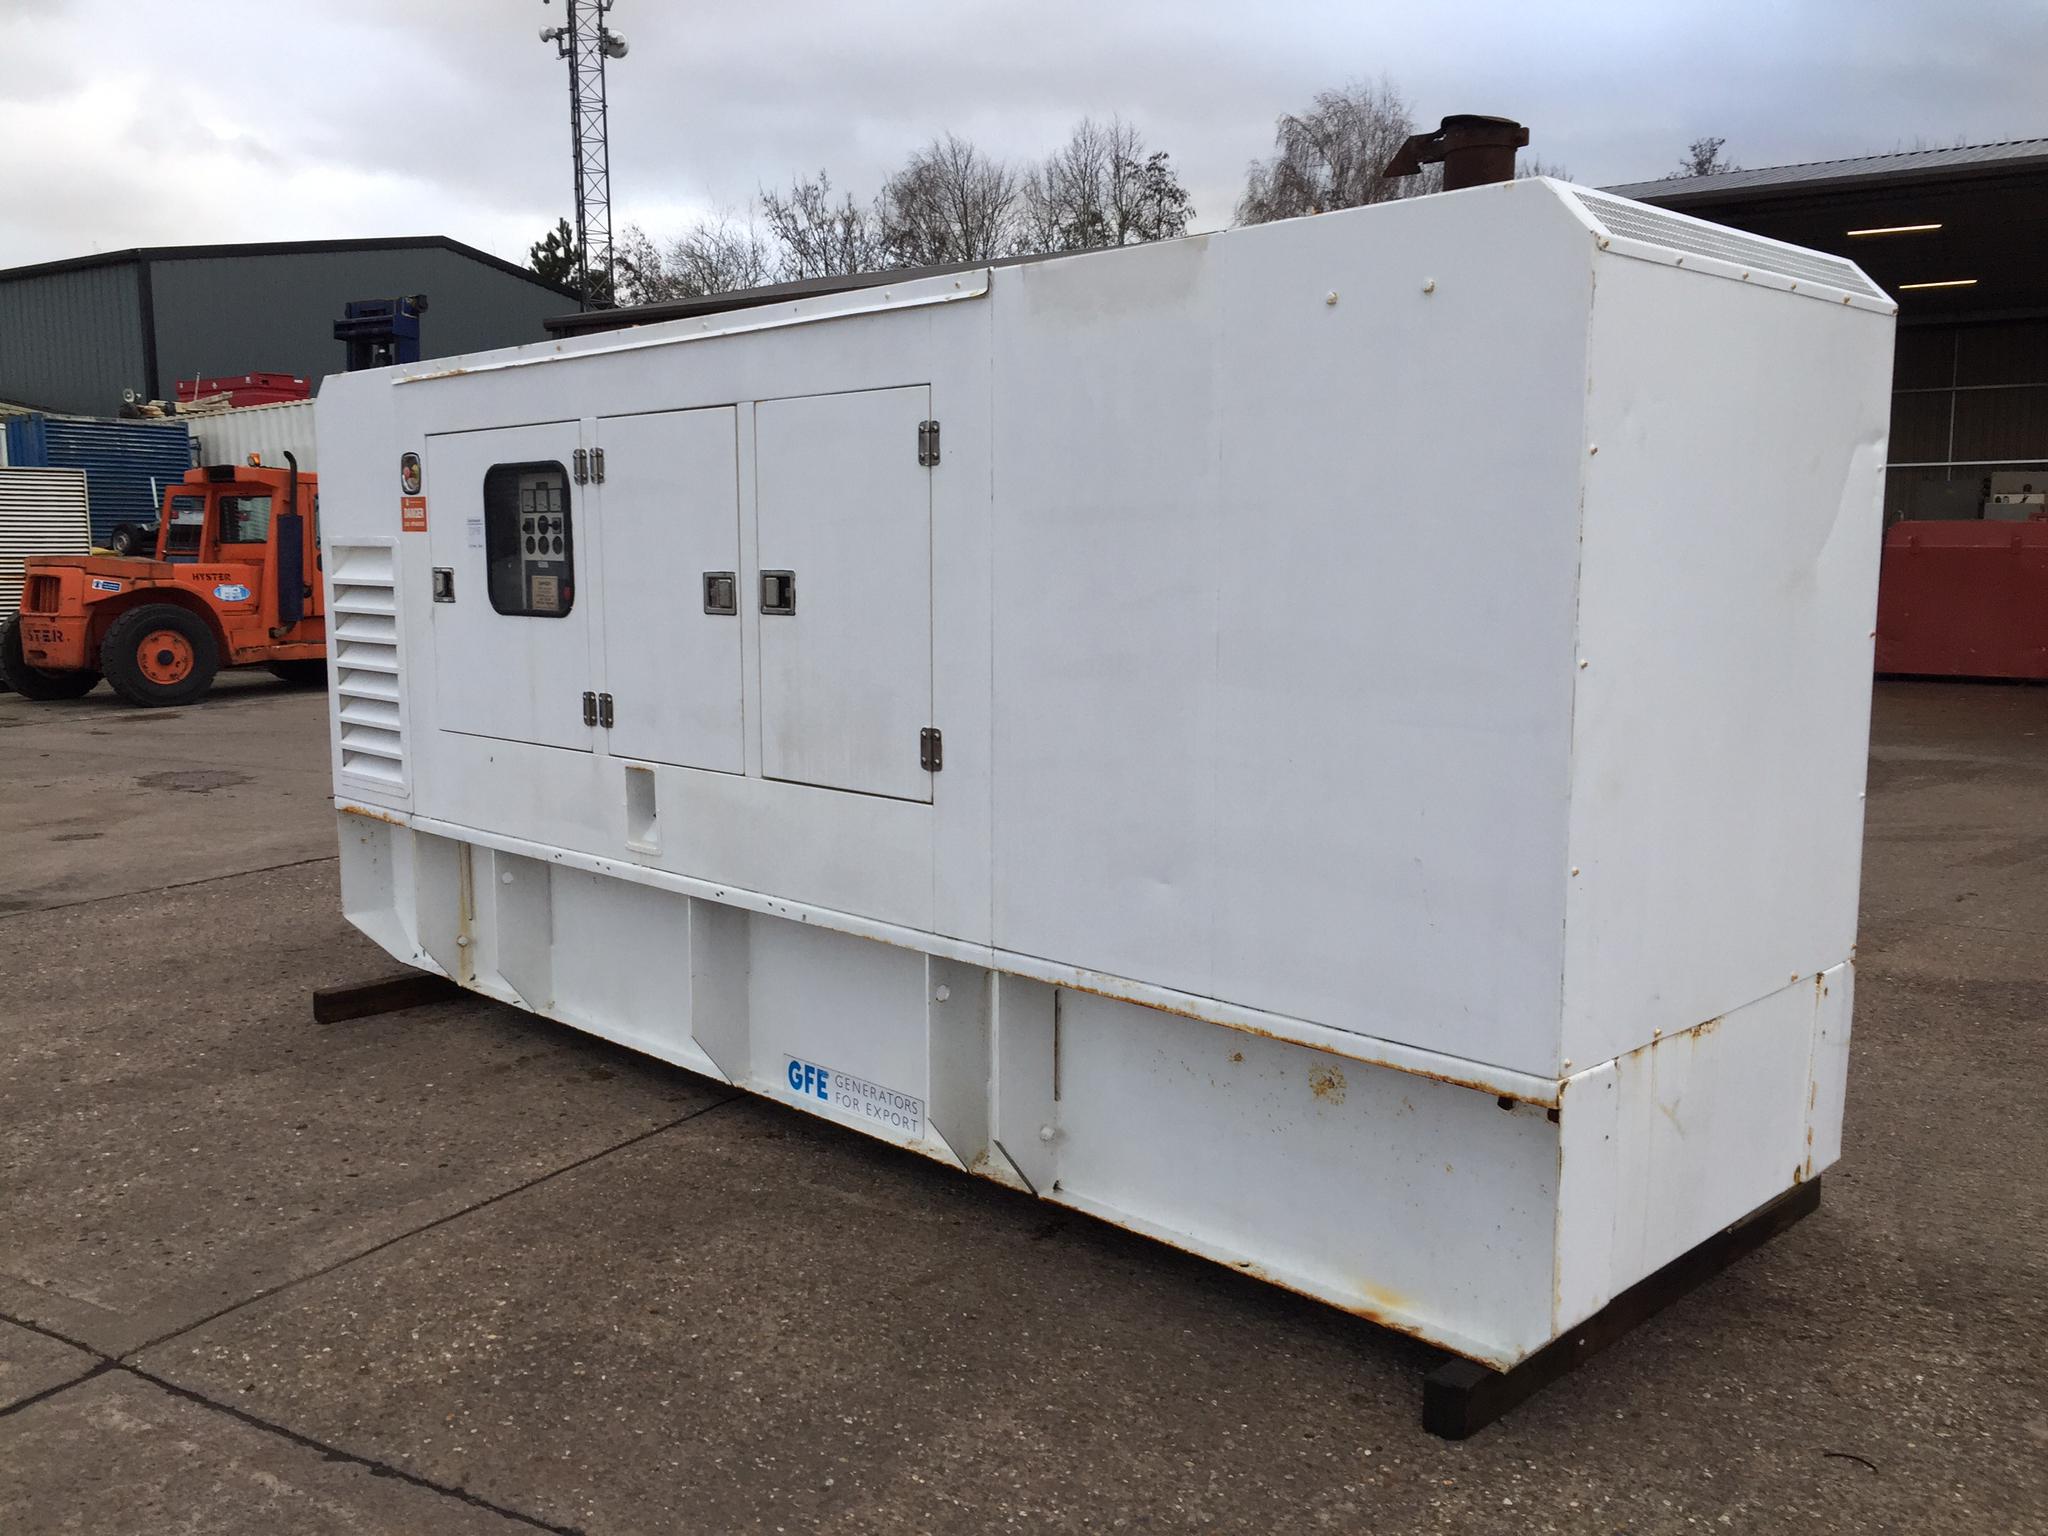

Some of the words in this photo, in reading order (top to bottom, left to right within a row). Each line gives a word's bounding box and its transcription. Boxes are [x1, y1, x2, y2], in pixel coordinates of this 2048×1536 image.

[192, 573, 232, 581] HYSTER
[788, 1060, 829, 1101] GFE
[834, 1074, 918, 1115] GENERATORS
[835, 1092, 860, 1112] FOR
[866, 1102, 919, 1133] EXPORT
